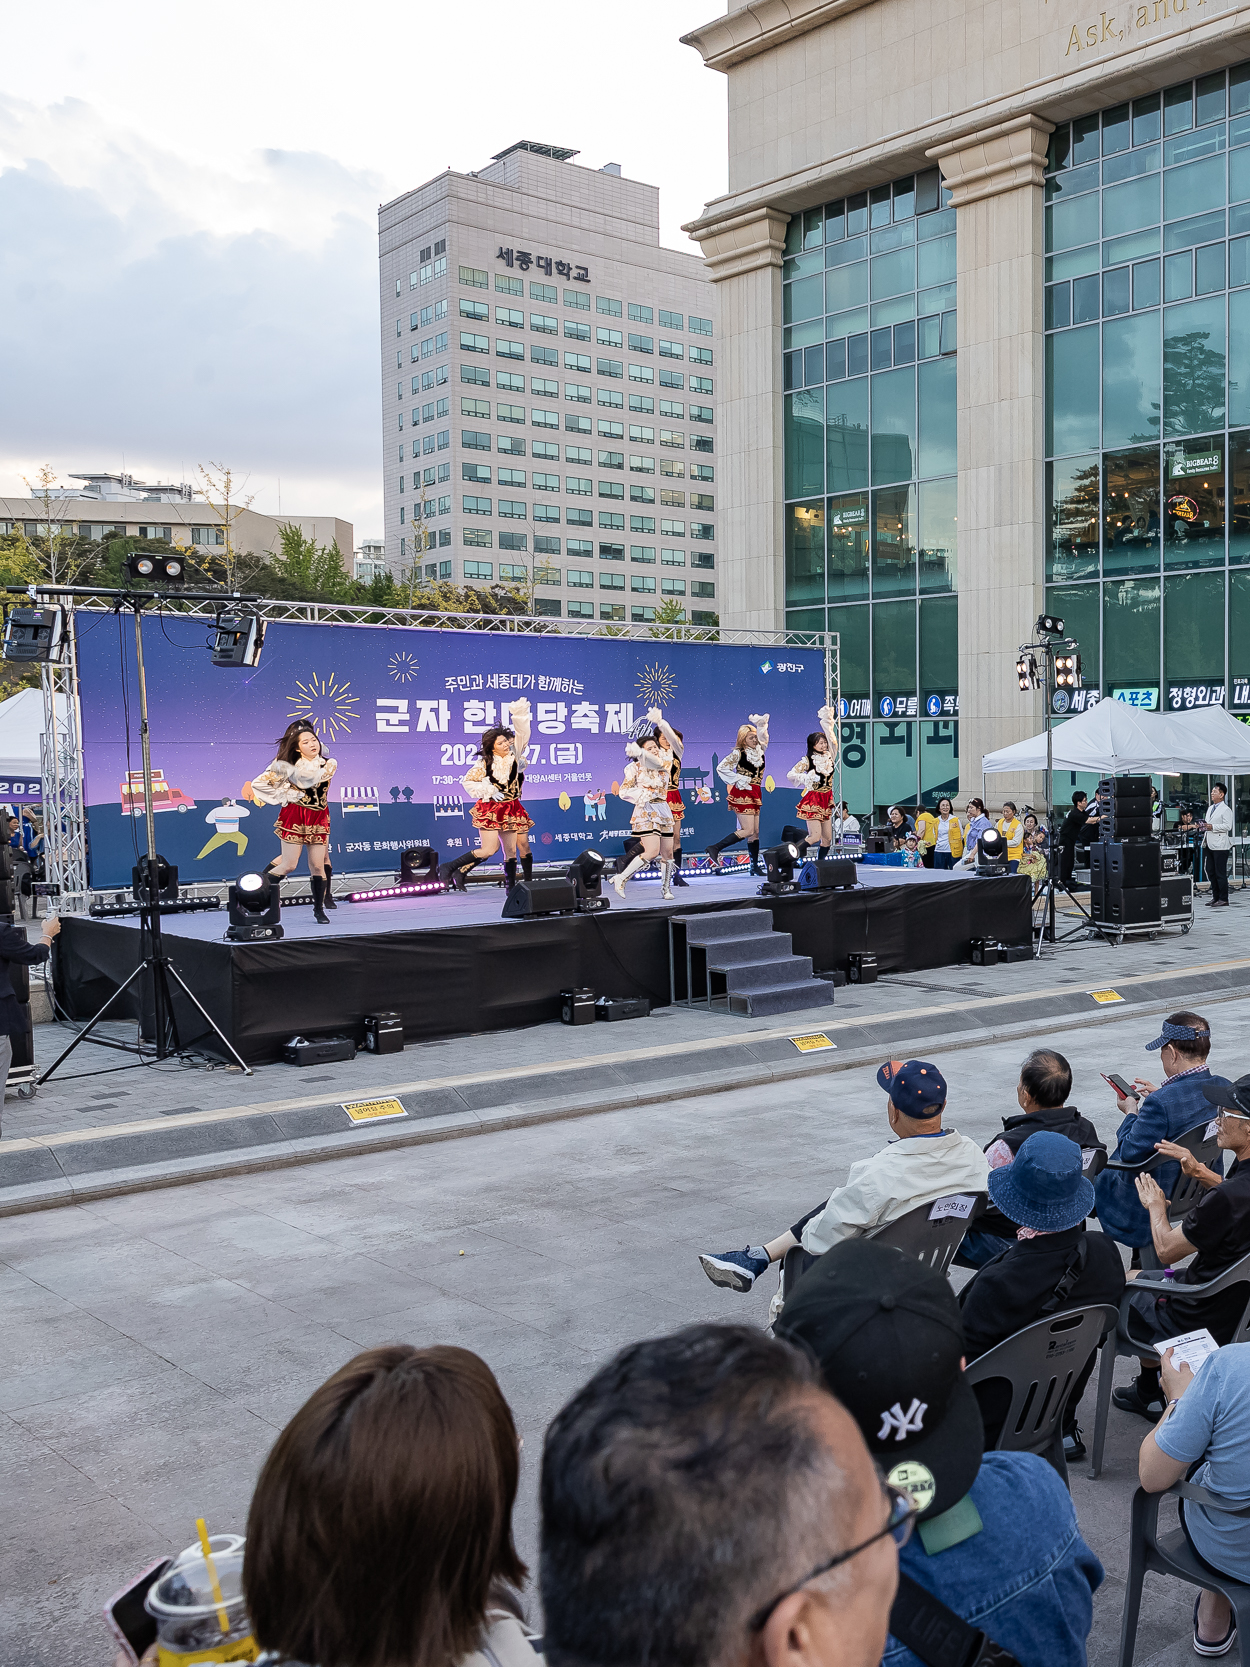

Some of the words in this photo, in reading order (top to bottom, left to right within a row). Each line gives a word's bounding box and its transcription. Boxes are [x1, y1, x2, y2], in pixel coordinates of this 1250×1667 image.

[1065, 11, 1124, 56] Ask,
[1136, 0, 1190, 29] and
[496, 246, 591, 283] 세종대학교
[776, 662, 805, 673] 광진구
[445, 674, 484, 693] 주민과
[485, 673, 536, 690] 세종대가
[537, 674, 585, 696] 함께하는
[895, 697, 917, 716] 무릎
[1071, 690, 1100, 711] 세종
[1117, 690, 1153, 706] 스포츠
[1169, 685, 1226, 708] 정형외과
[375, 698, 451, 734] 군자
[525, 773, 562, 784] 대양AI센터
[563, 772, 592, 783] 거울연못
[345, 842, 372, 853] 군자동
[373, 838, 431, 851] 문화행사위원회
[446, 837, 463, 847] 후원
[554, 832, 594, 843] 세종대학교
[877, 1398, 928, 1441] NY
